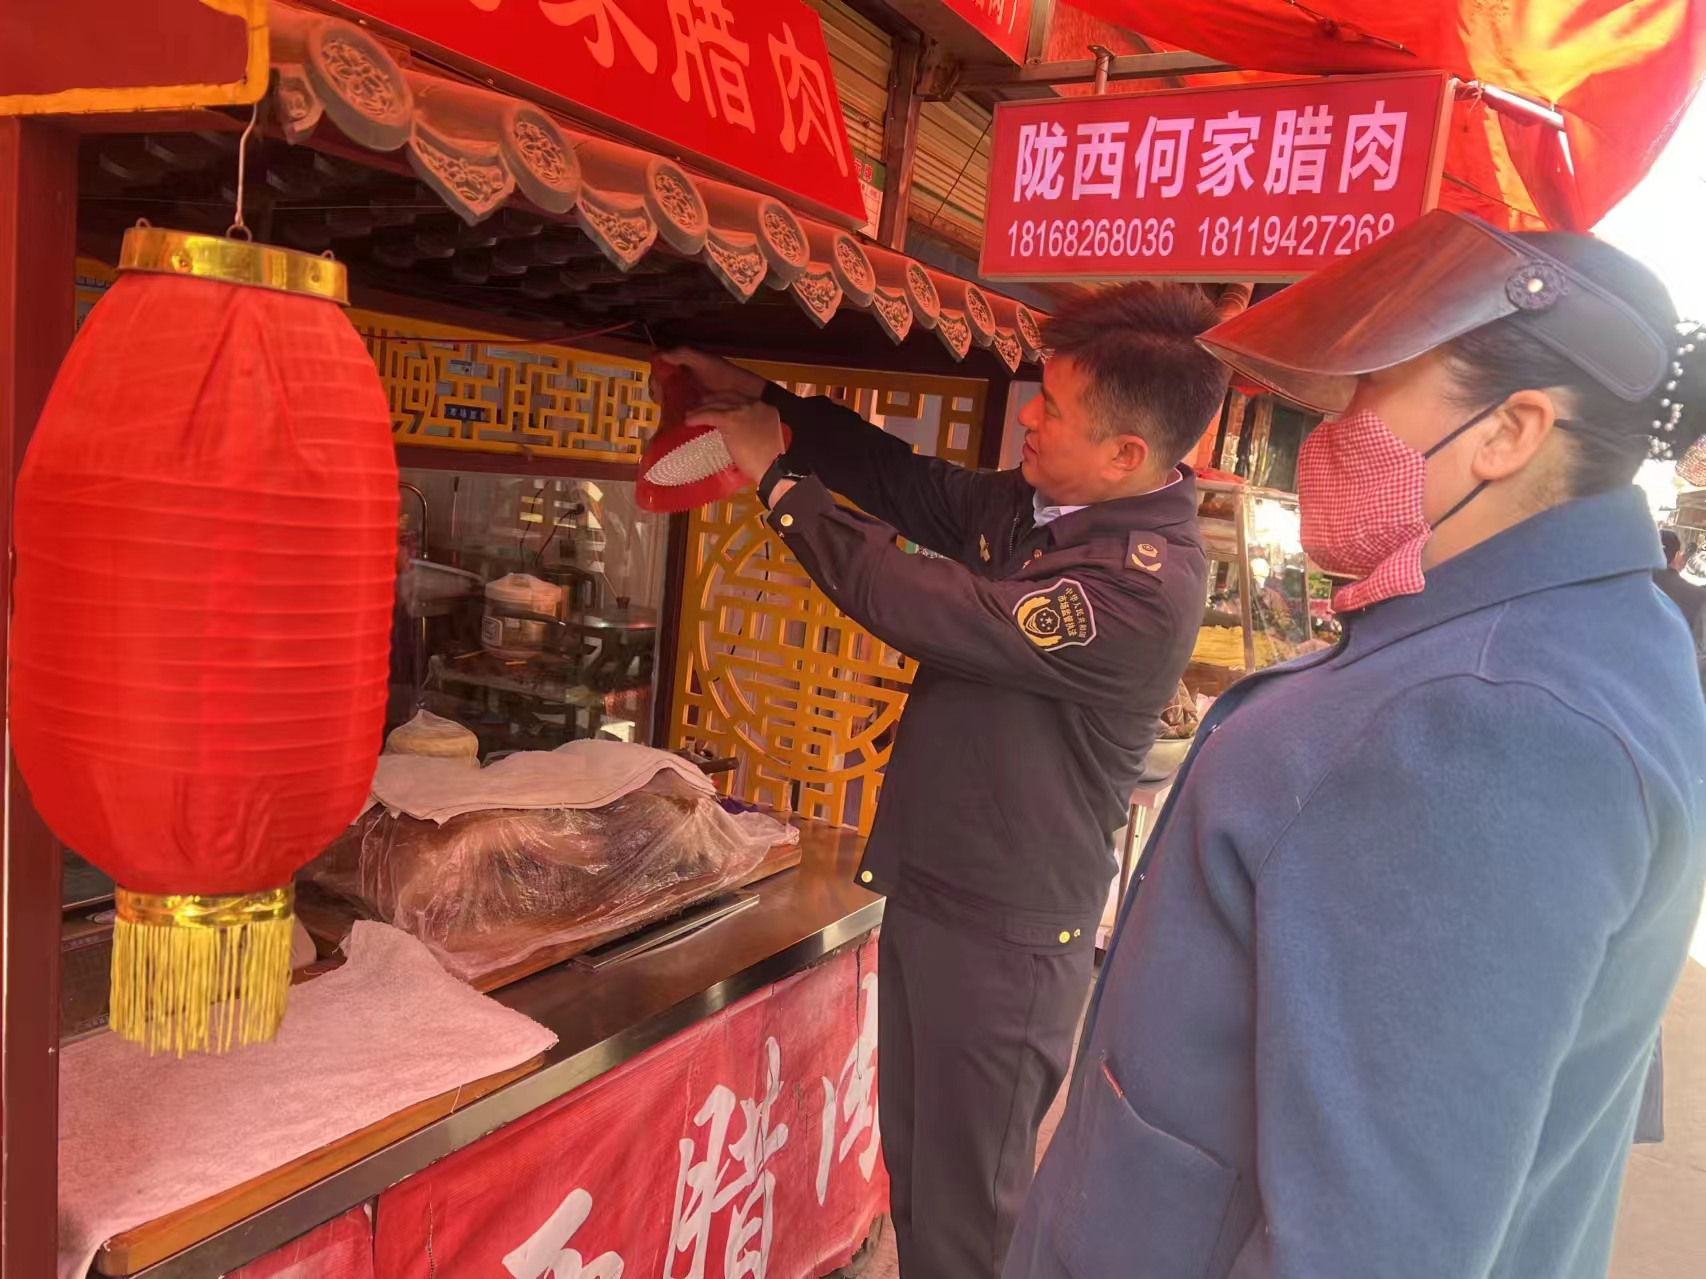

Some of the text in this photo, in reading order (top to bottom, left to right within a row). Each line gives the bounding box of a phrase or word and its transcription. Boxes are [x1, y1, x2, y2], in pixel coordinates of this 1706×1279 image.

[1013, 100, 1408, 202] 陇西何家腊肉
[1008, 213, 1395, 257] 18168268036 18119427268
